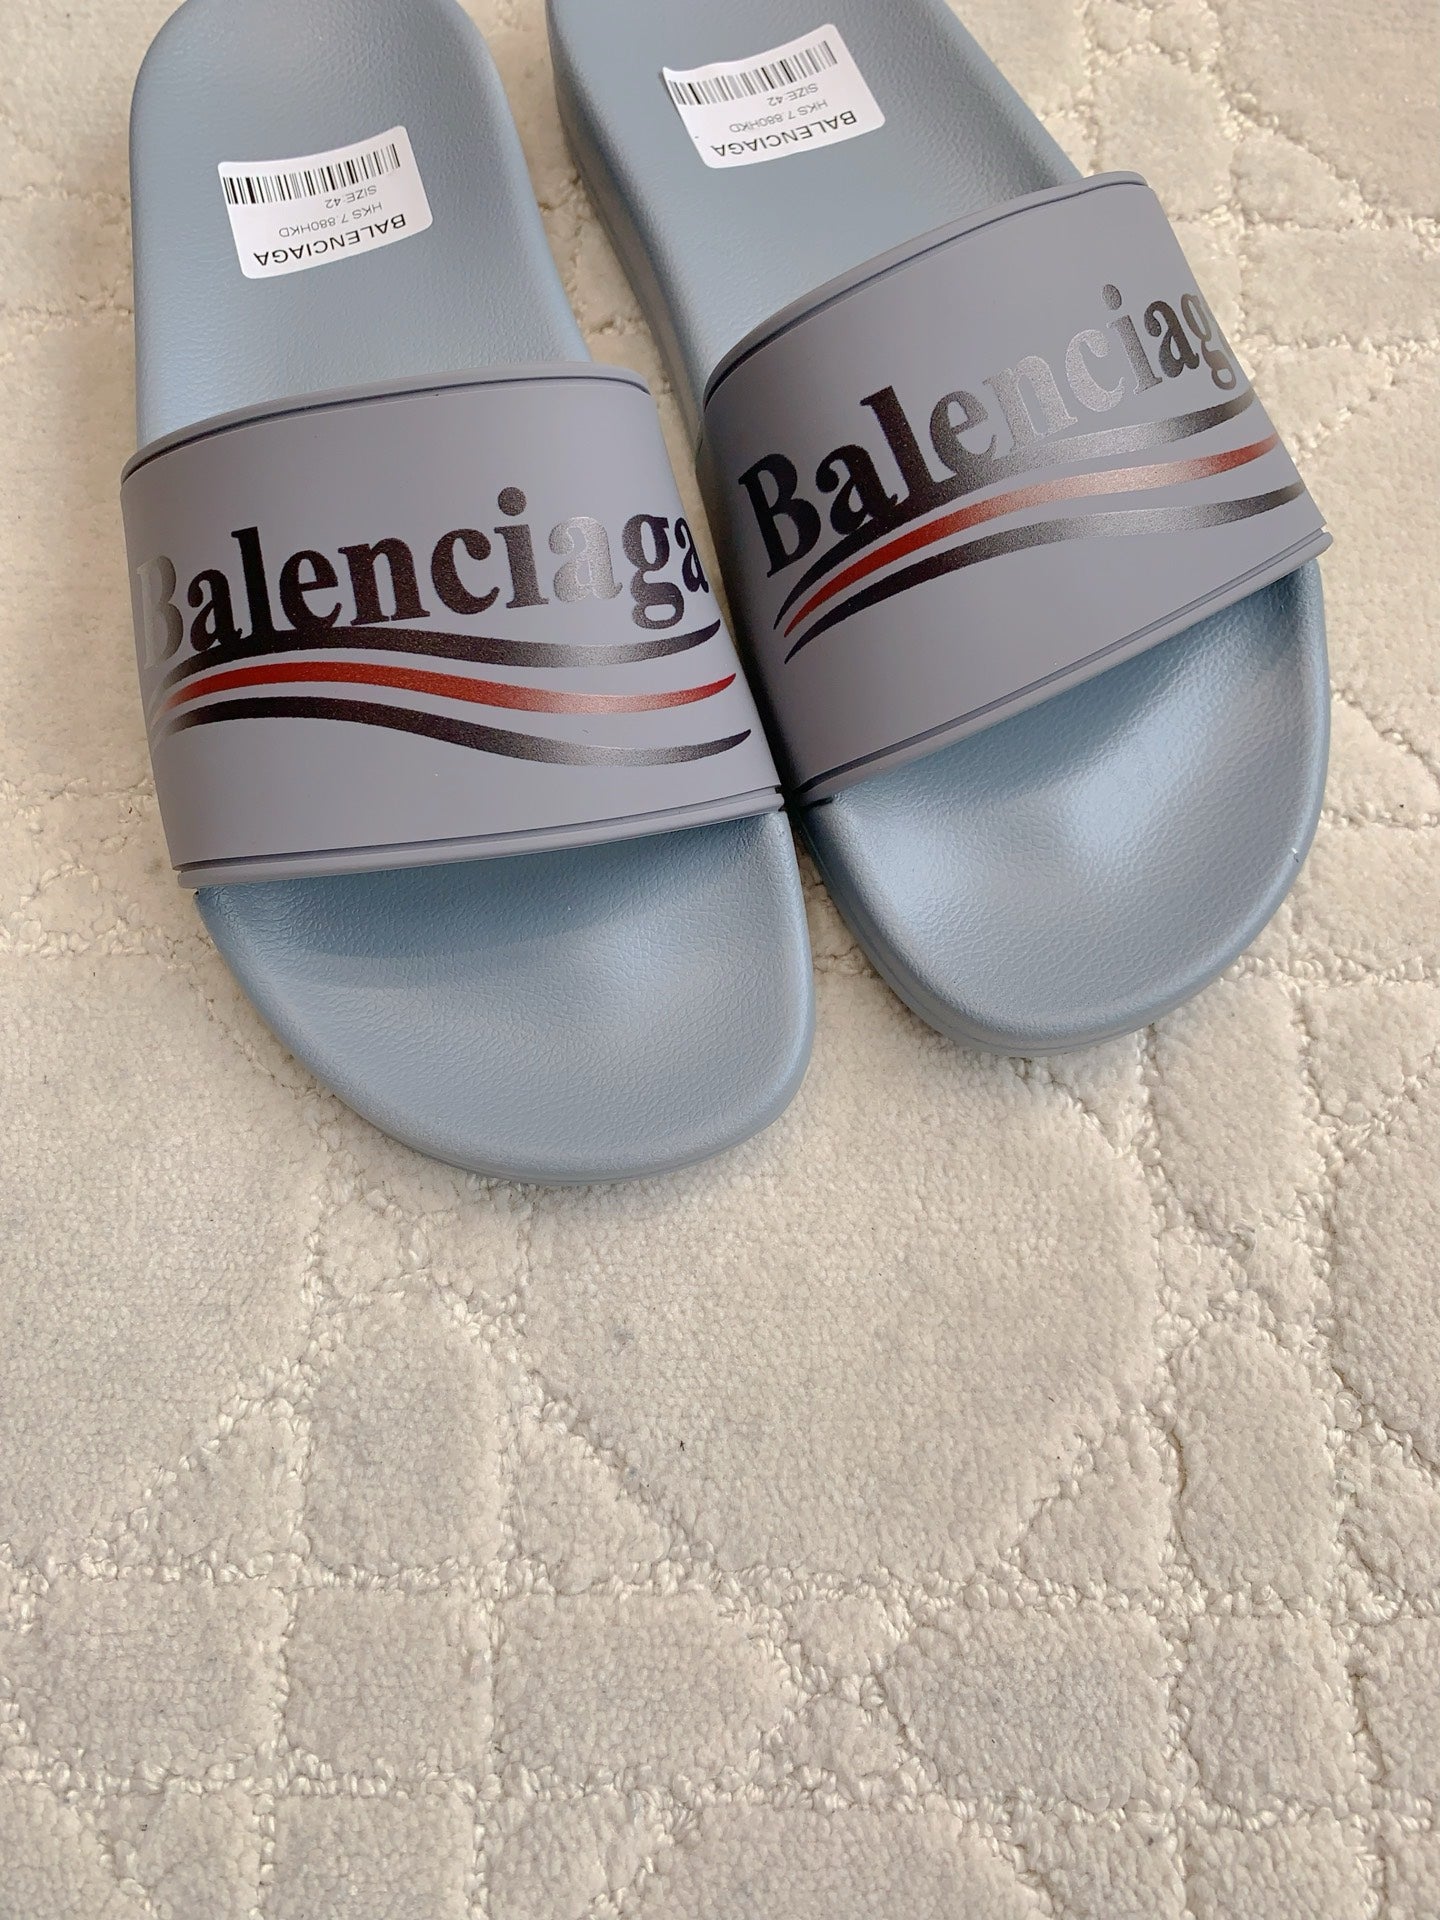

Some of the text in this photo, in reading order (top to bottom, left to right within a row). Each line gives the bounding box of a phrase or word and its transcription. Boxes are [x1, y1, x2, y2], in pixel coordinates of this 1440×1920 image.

[799, 99, 829, 116] HKS
[711, 110, 858, 157] BALENCIAGA
[352, 202, 383, 219] HKS
[253, 213, 407, 266] BALENCIAGA
[738, 283, 1237, 578] Balenciag
[137, 486, 709, 671] Balenciaga
